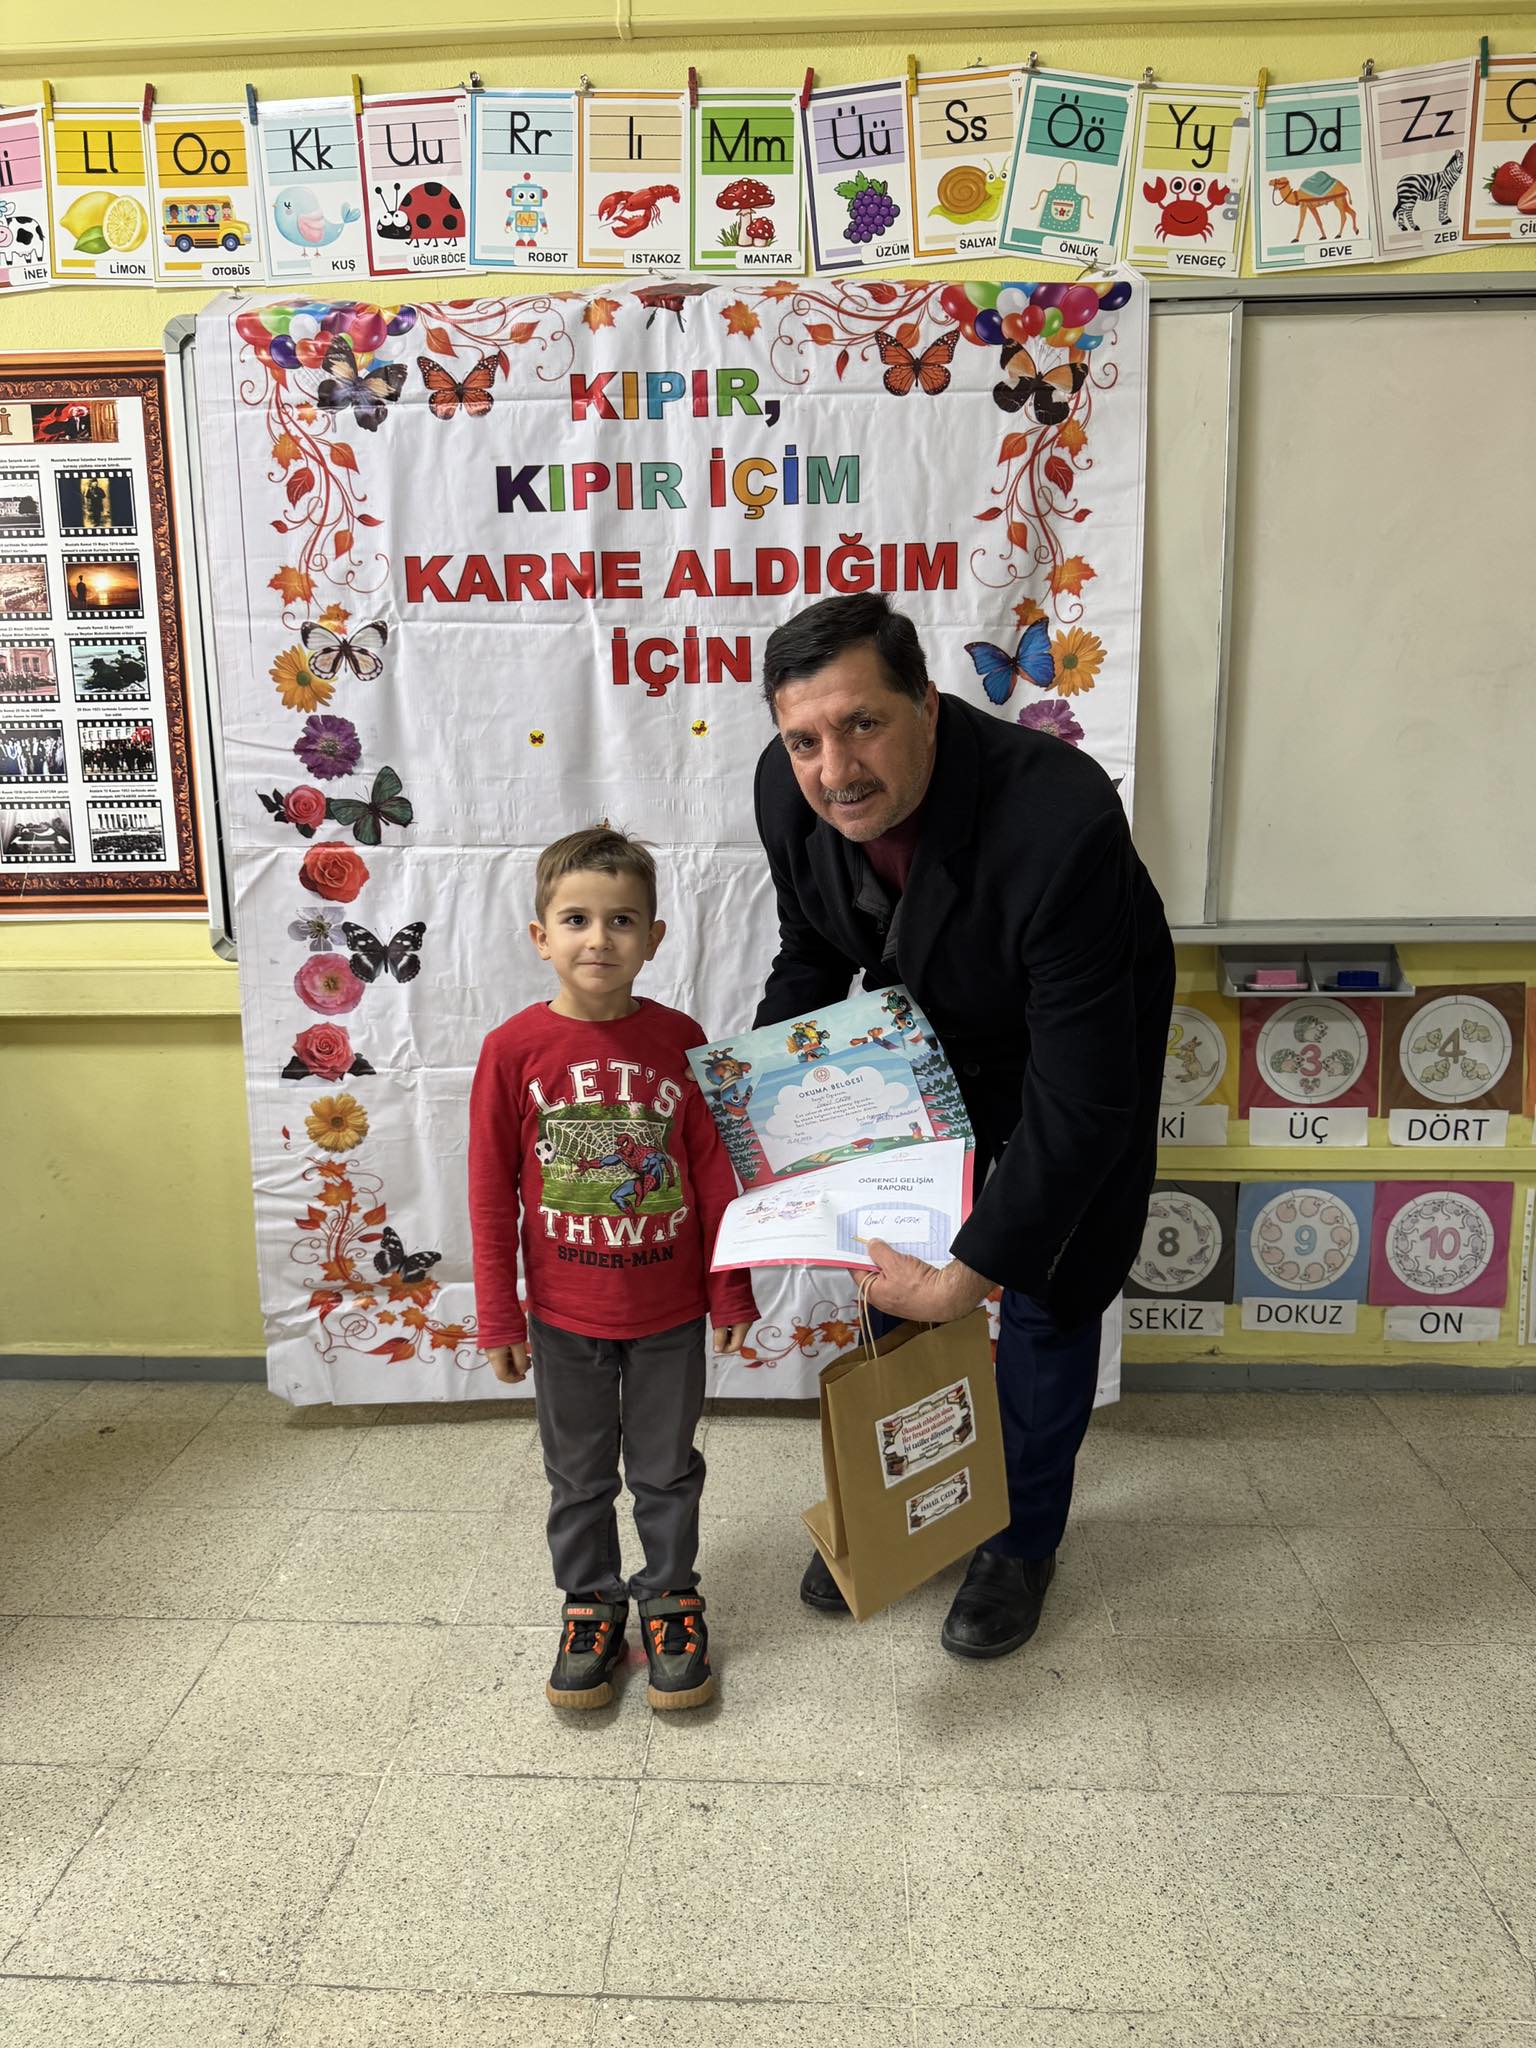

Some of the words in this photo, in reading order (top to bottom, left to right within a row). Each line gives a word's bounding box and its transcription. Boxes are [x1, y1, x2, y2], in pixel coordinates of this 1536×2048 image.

[945, 99, 987, 144] Ss
[1400, 96, 1454, 143] Zz
[1506, 79, 1536, 133] Ç
[510, 111, 552, 155] Rr
[832, 106, 891, 160] Üü
[1047, 93, 1105, 153] Öö
[1168, 104, 1216, 169] Yy
[1285, 108, 1342, 157] Dd
[84, 131, 119, 173] Ll
[173, 133, 230, 175] Oo
[290, 128, 333, 171] Kk
[386, 122, 443, 167] Uu
[709, 118, 785, 162] Mm
[1434, 231, 1460, 244] ZEB
[1520, 220, 1536, 236] ÇİL
[413, 253, 440, 266] UĞUR
[441, 251, 466, 264] BÖCE
[527, 251, 569, 264] ROBOT
[631, 252, 681, 265] ISTAKOZ
[743, 252, 793, 265] MANTAR
[876, 243, 910, 258] ÜZÜM
[1059, 240, 1099, 258] ÖNLÜK
[1175, 252, 1227, 270] YENGEÇ
[1319, 243, 1353, 258] DEVE
[109, 261, 146, 276] LİMON
[212, 263, 251, 278] OTOBÜS
[331, 257, 356, 274] KUŞ
[569, 368, 781, 428] KIPIR,
[495, 461, 687, 514] KIPIR
[709, 444, 861, 520] İÇİM
[403, 549, 643, 604] KARNE
[663, 532, 958, 599] ALDIĞIM
[611, 625, 753, 697] İÇİN
[1300, 1043, 1323, 1077] 3
[1438, 1027, 1466, 1065] 4
[528, 1057, 685, 1119] LET'S
[798, 1087, 829, 1099] OKUMA
[830, 1075, 864, 1091] BELGESİ
[1160, 1112, 1185, 1139] Kİ
[1288, 1112, 1329, 1144] ÜÇ
[1407, 1113, 1490, 1142] DÖRT
[877, 1184, 914, 1192] RAPORU
[900, 1175, 935, 1185] GELİŞİM
[1157, 1226, 1181, 1257] 8
[1294, 1225, 1318, 1256] 9
[1420, 1225, 1461, 1261] 10
[558, 1245, 675, 1270] SPIDER-MAN
[1128, 1303, 1204, 1330] SEKİZ
[1256, 1303, 1343, 1325] DOKUZ
[1419, 1311, 1463, 1334] ON
